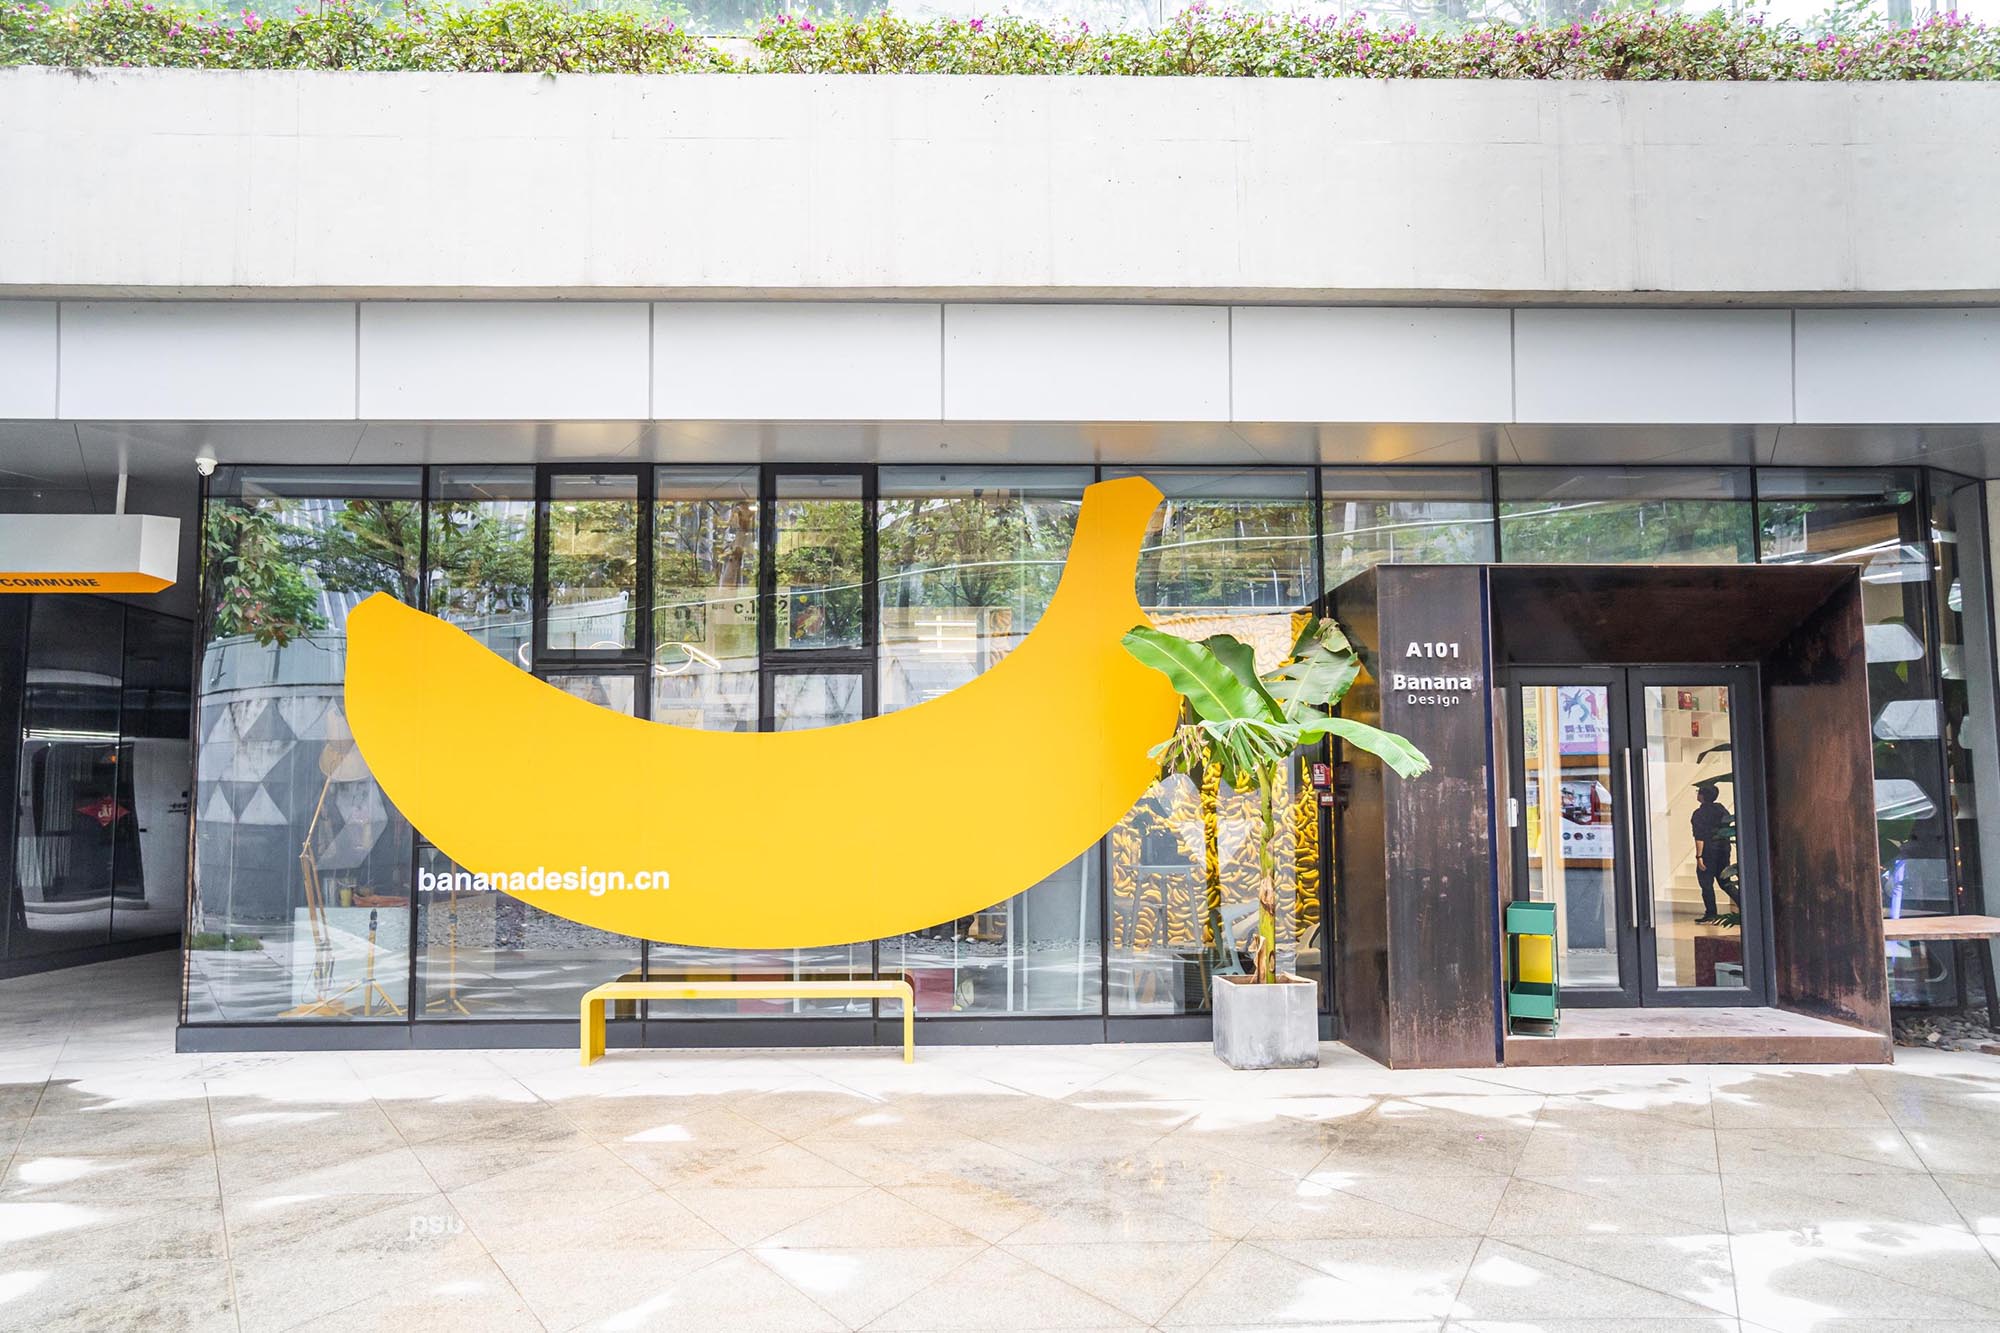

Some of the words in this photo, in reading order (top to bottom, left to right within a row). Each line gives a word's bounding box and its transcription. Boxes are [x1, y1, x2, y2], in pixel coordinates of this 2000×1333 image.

[0, 578, 100, 587] COMMUNE
[1405, 642, 1459, 658] A101
[1393, 674, 1472, 690] Banana
[1407, 694, 1459, 707] Design
[418, 866, 669, 896] bananadesign.cn
